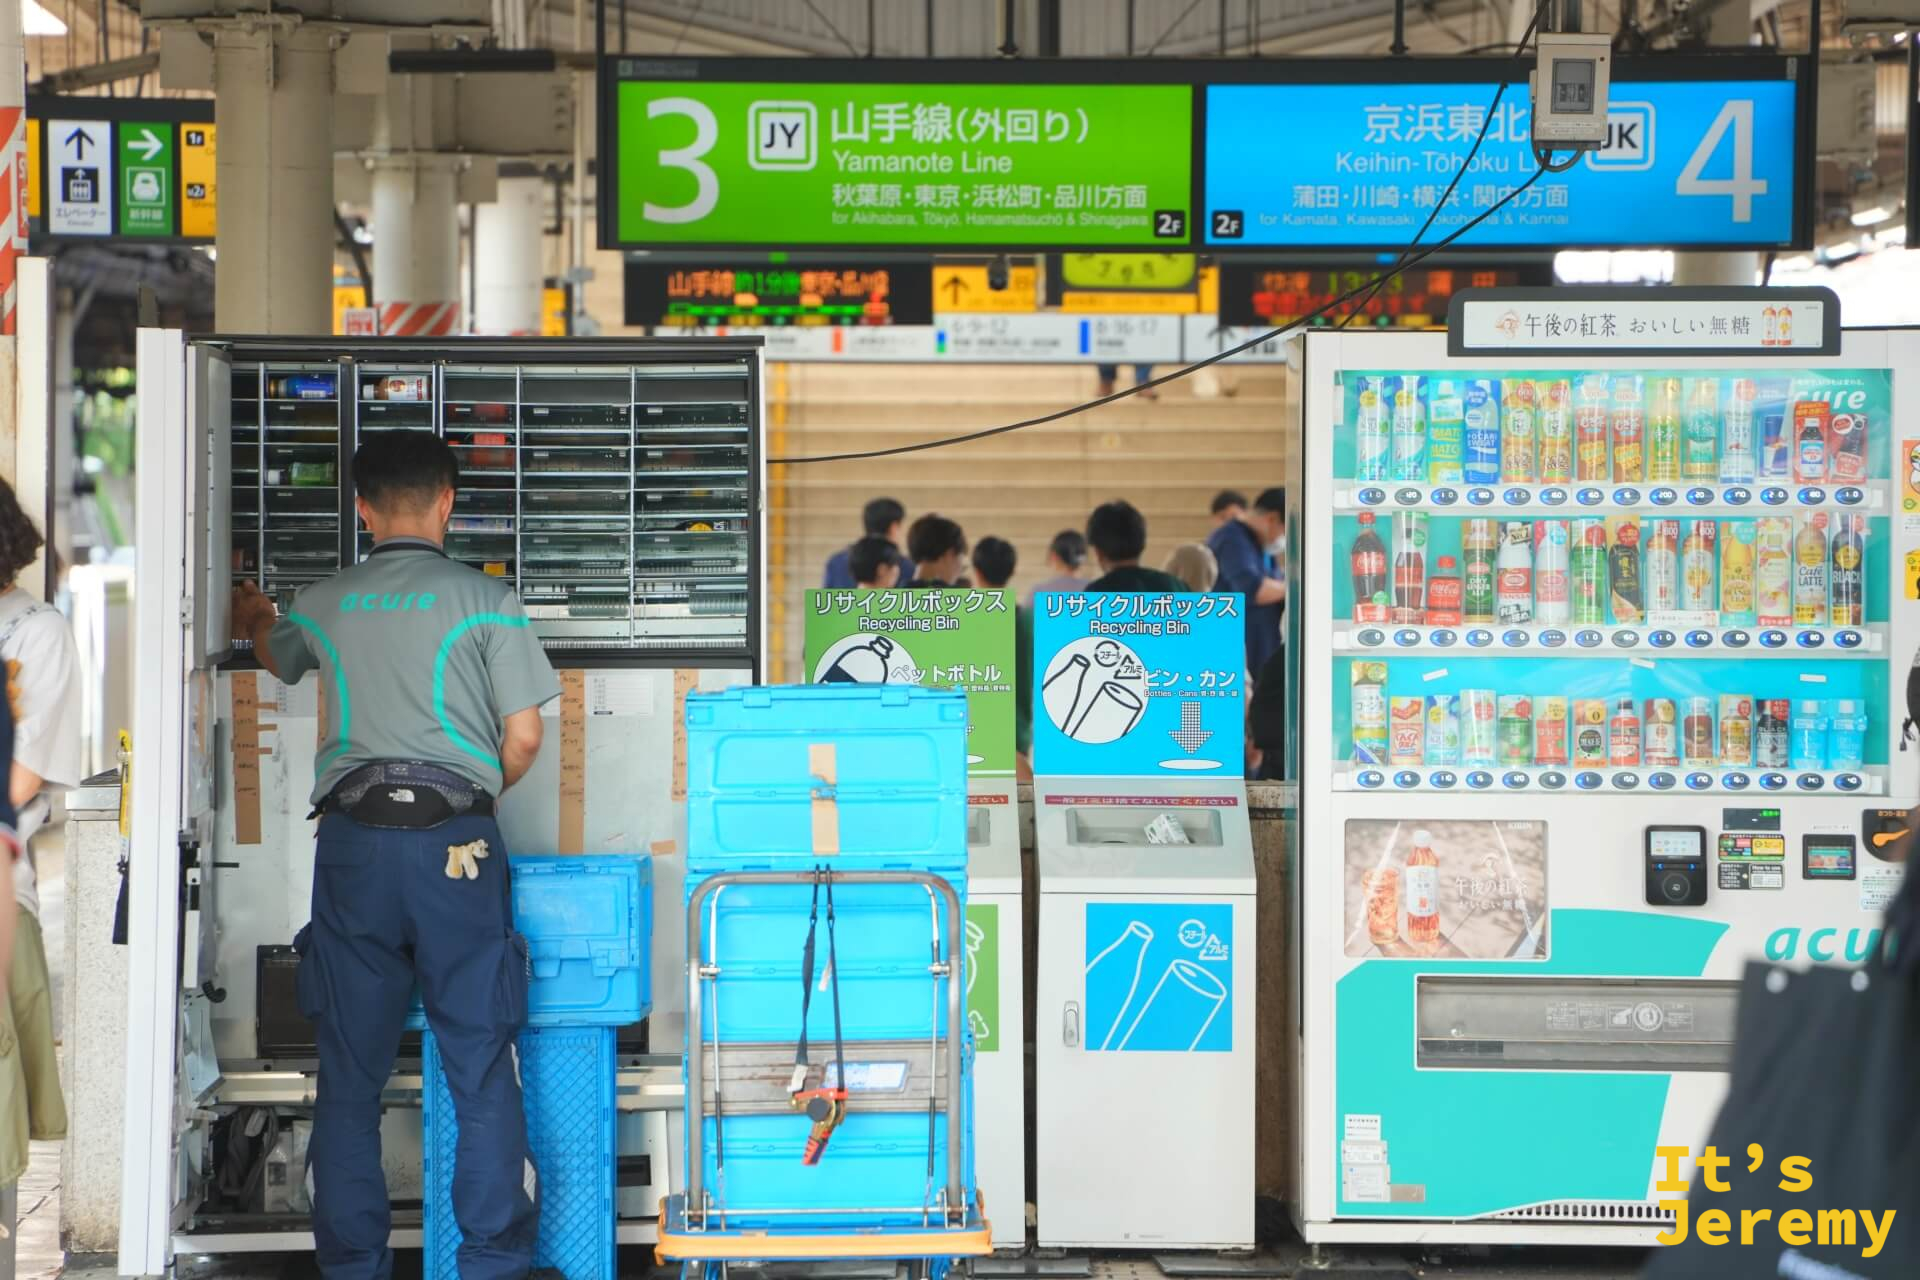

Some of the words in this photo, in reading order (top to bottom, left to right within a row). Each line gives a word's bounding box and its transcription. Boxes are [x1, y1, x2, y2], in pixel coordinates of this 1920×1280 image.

[831, 101, 1089, 144] 山手線(外回り)
[1363, 103, 1529, 143] 京浜東北
[764, 123, 800, 149] JY
[1601, 123, 1638, 149] JK
[643, 97, 719, 224] 3
[832, 150, 953, 173] Yamanote
[961, 151, 1013, 173] Line
[1676, 99, 1768, 222] 4
[832, 212, 848, 225] for
[1067, 212, 1076, 225] &
[1080, 212, 1149, 229] Shinagawa
[1158, 214, 1182, 235] 2F
[1216, 214, 1240, 235] 2F
[1259, 212, 1277, 225] for
[1504, 213, 1514, 225] &
[1518, 212, 1569, 225] Kannai
[1525, 313, 1616, 337] 午後の紅茶
[1799, 576, 1824, 586] LATTE
[340, 592, 438, 612] acure
[814, 589, 1007, 615] リサイクルボックス
[1047, 594, 1239, 618] リサイクルボックス
[858, 616, 933, 632] Recycling
[935, 616, 960, 630] Bin
[1089, 620, 1163, 636] Recycling
[1166, 621, 1191, 635] Bin
[891, 664, 1002, 683] ペットボトル
[1143, 670, 1237, 688] ビン・カン
[1765, 927, 1886, 962] acu
